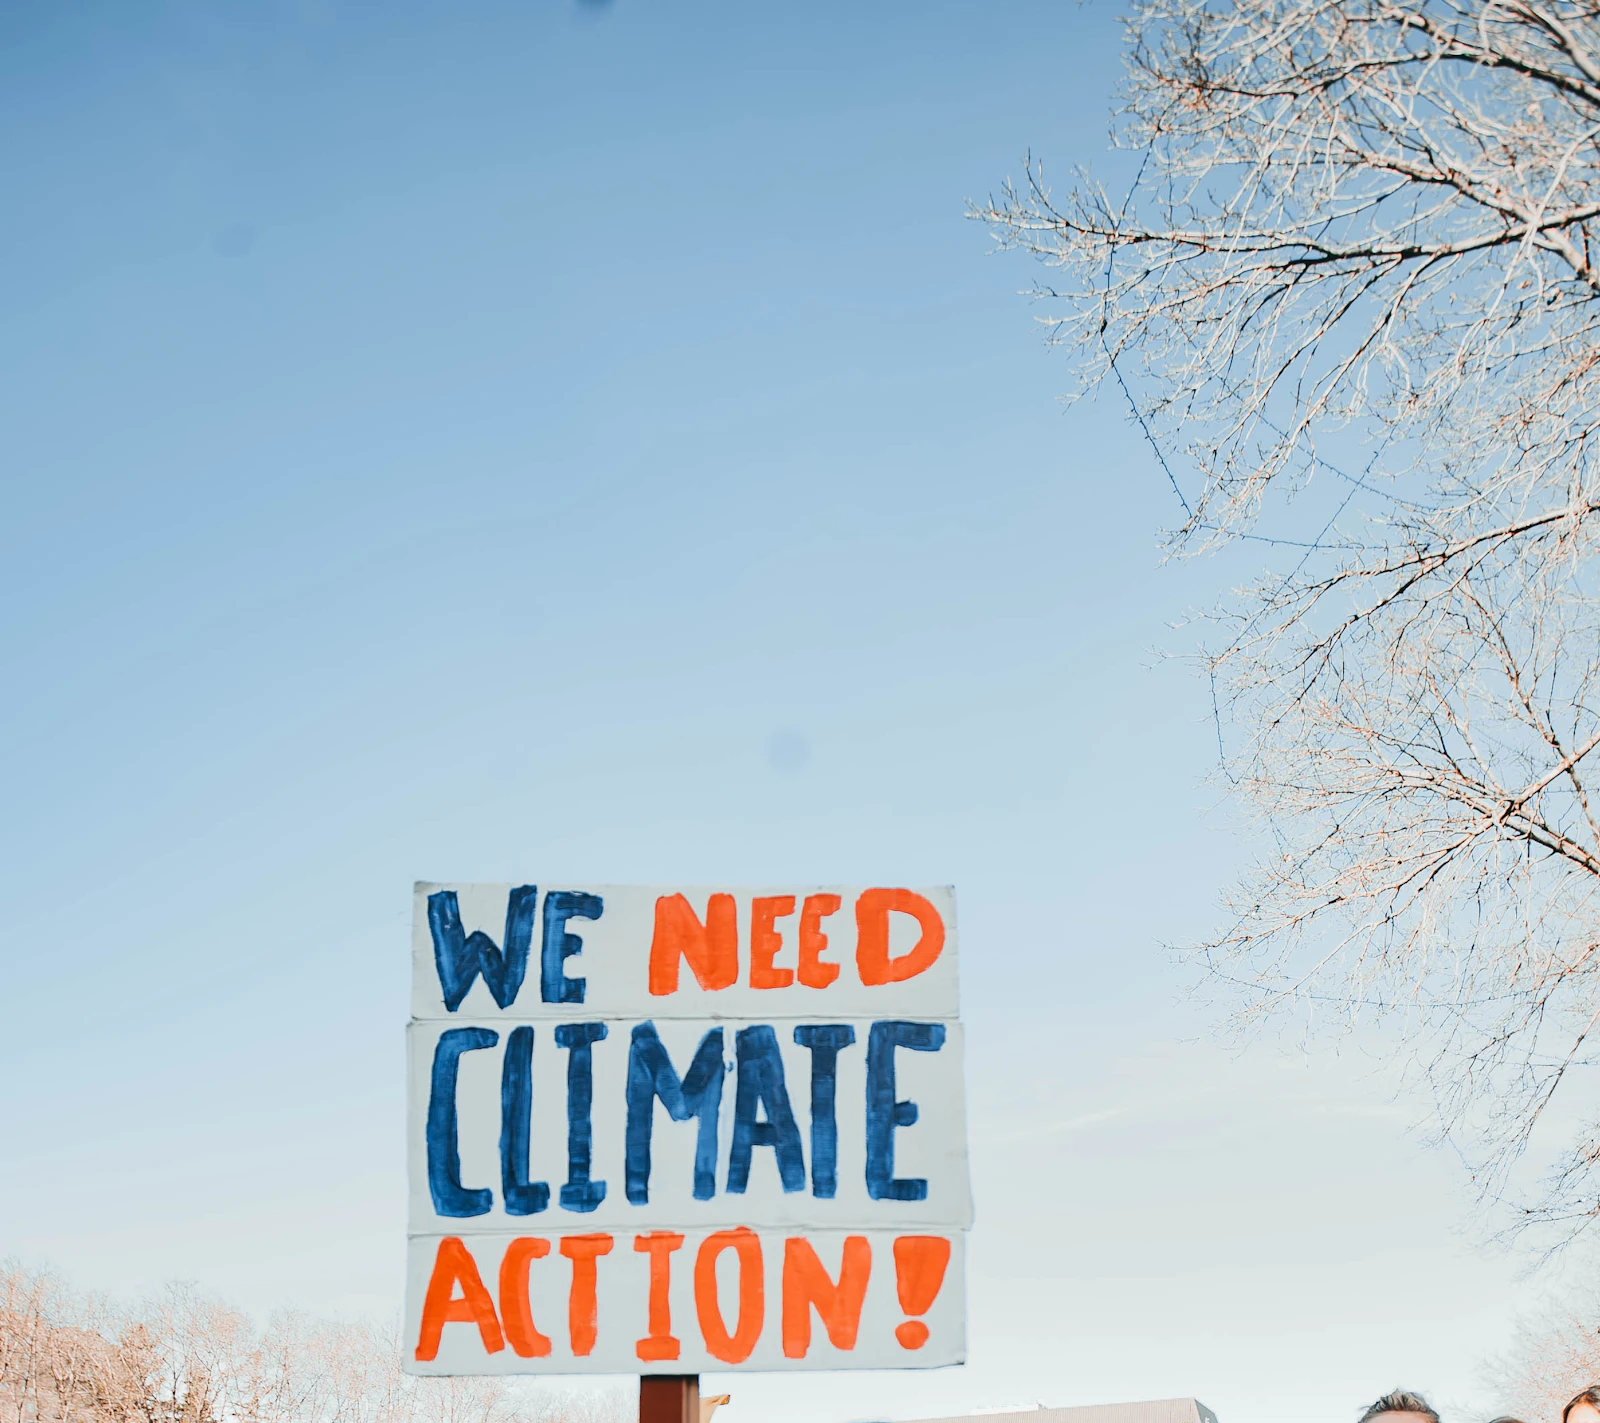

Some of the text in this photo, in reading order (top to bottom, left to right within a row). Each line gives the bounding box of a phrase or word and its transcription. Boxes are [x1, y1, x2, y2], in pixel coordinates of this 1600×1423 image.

[427, 884, 946, 1012] WE NEED
[427, 1020, 946, 1218] CLIMATE
[415, 1225, 951, 1364] ACTION!
